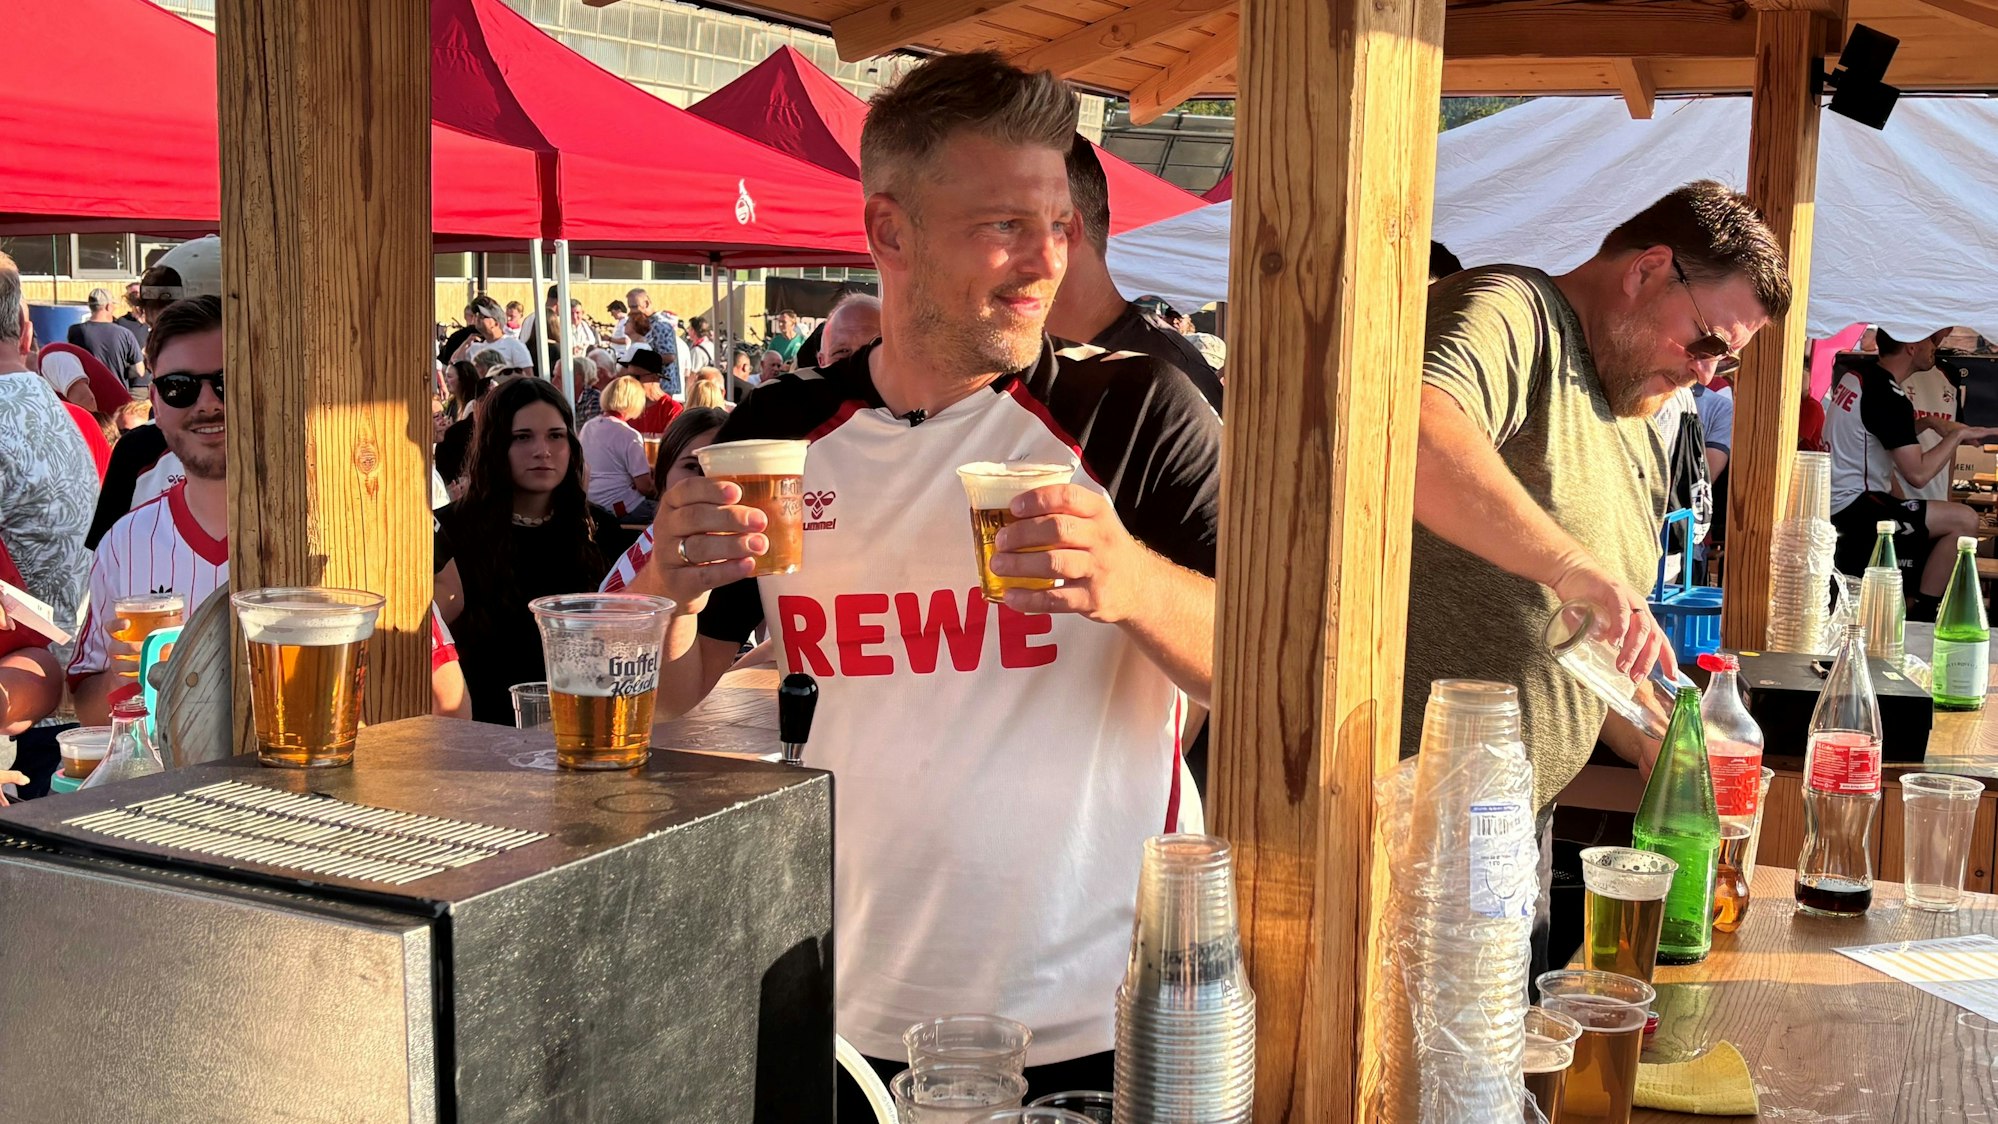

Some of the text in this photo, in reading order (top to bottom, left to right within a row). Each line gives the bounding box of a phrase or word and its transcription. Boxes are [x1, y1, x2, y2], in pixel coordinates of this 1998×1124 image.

[1831, 384, 1858, 412] EWE
[803, 518, 836, 531] ummel
[1898, 559, 1914, 568] WE
[778, 586, 1058, 677] REWE
[609, 651, 658, 677] Gaffel
[610, 674, 656, 700] Kölsch
